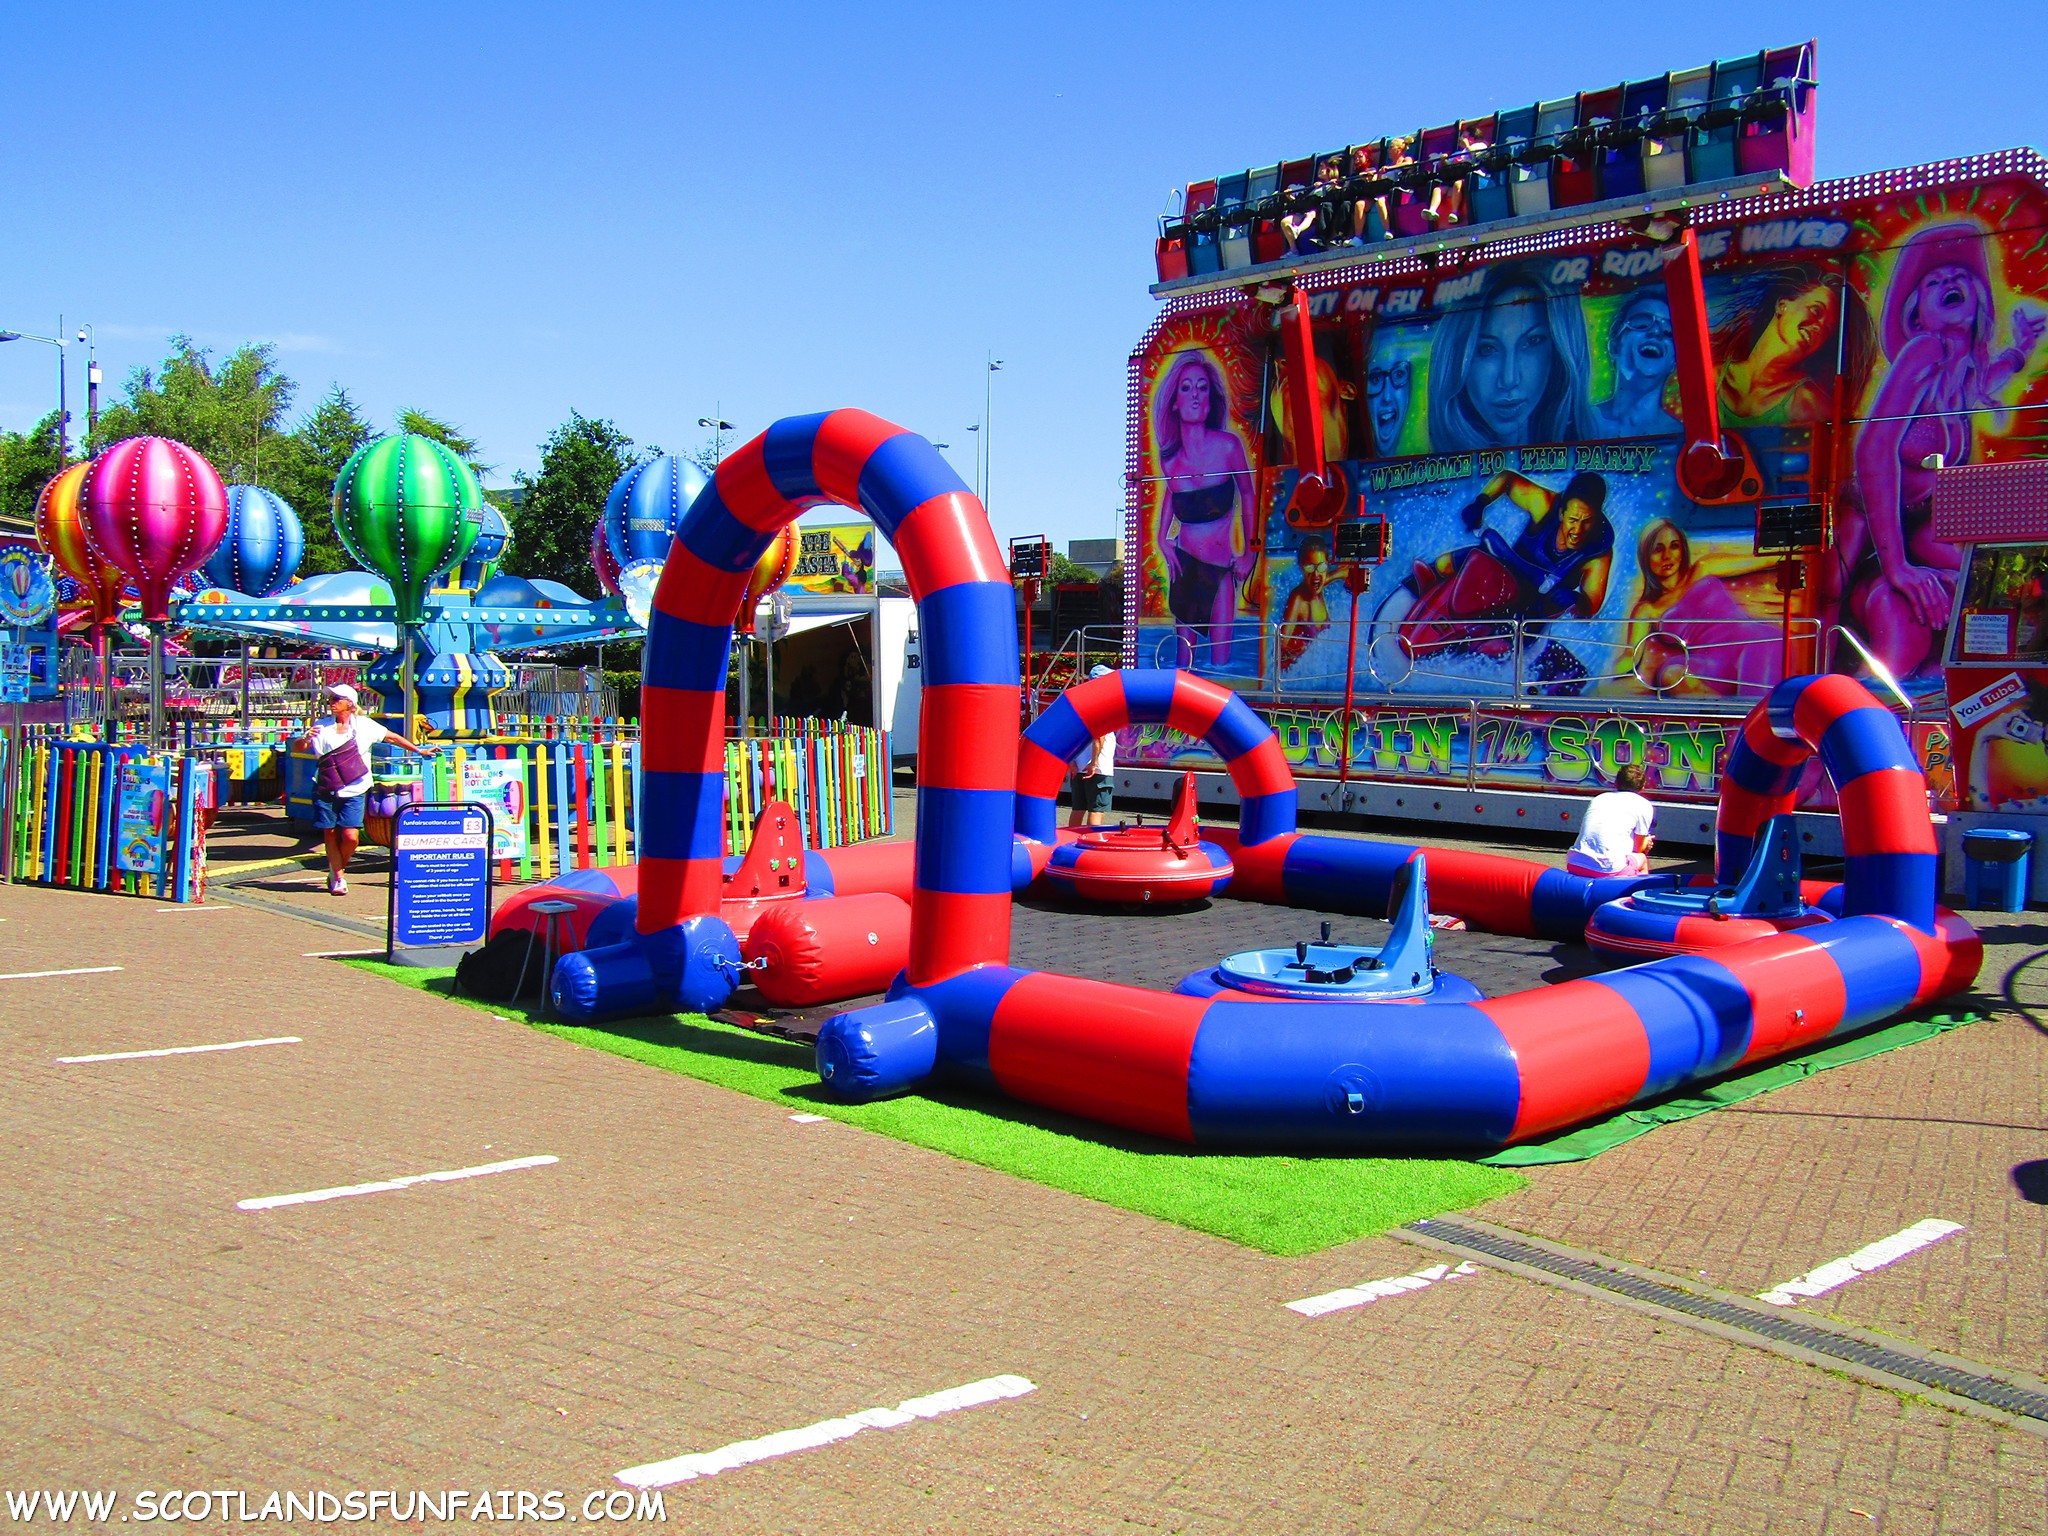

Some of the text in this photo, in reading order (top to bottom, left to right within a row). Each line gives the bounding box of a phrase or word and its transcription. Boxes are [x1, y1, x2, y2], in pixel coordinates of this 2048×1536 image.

[1386, 287, 1424, 313] FLY
[1550, 256, 1589, 285] OR
[1370, 445, 1656, 492] WELCOME TO THE PARTY
[1254, 708, 1360, 767] UN
[1373, 711, 1458, 775] IN
[1476, 715, 1534, 767] The
[464, 770, 504, 779] BALLOONS
[464, 778, 492, 787] NOTICE
[466, 820, 481, 831] £3
[403, 836, 450, 847] BUMPER
[453, 836, 483, 846] CARS
[778, 835, 784, 847] 1
[410, 852, 475, 861] IMPORTANT RULES
